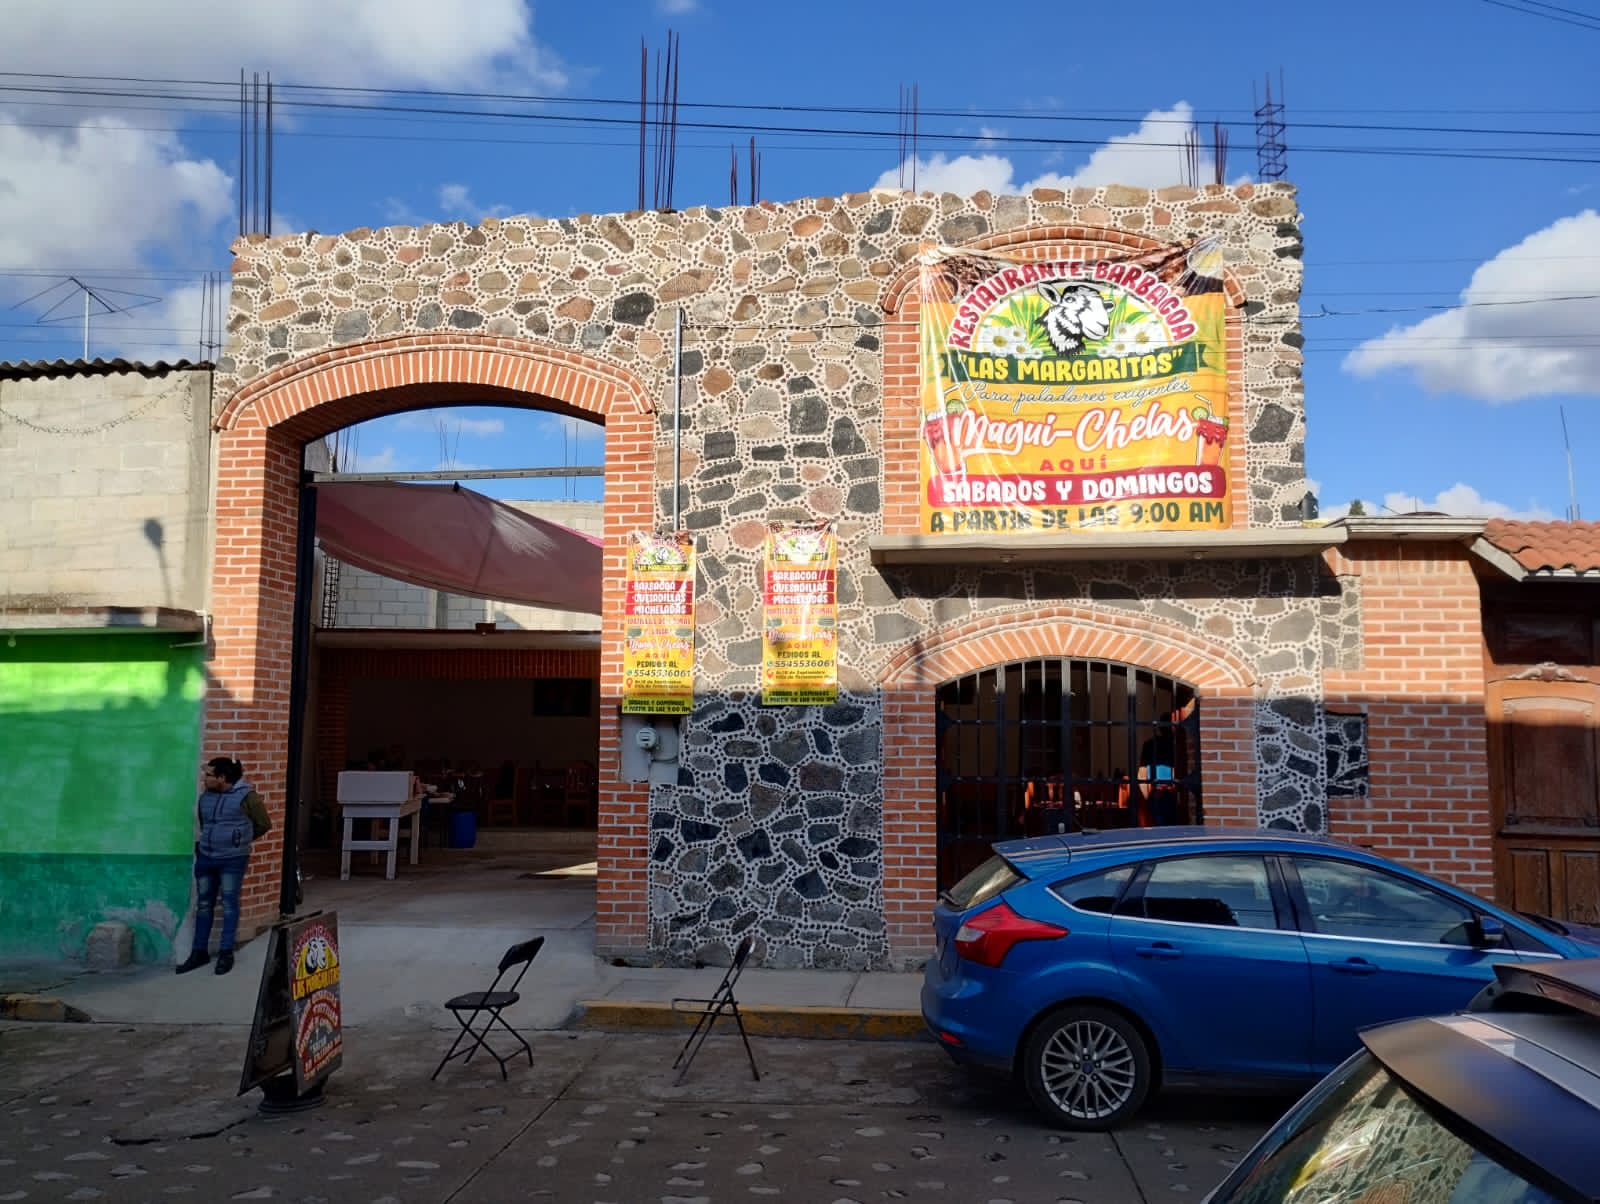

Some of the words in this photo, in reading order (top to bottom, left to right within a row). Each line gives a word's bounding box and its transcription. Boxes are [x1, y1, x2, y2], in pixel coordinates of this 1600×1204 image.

[962, 380, 1011, 402] Para
[1012, 385, 1106, 415] paladares
[1113, 376, 1192, 408] exigentes
[1039, 454, 1107, 472] AQUÍ
[1055, 480, 1073, 501] Y
[1082, 472, 1213, 501] DOMINGOS
[930, 511, 945, 532] A
[953, 509, 1032, 531] PARTIR
[1041, 508, 1070, 529] DE
[1078, 504, 1119, 528] LAS
[1130, 502, 1181, 523] 9:00
[1189, 501, 1225, 523] AM
[634, 604, 687, 615] MICHELADAS
